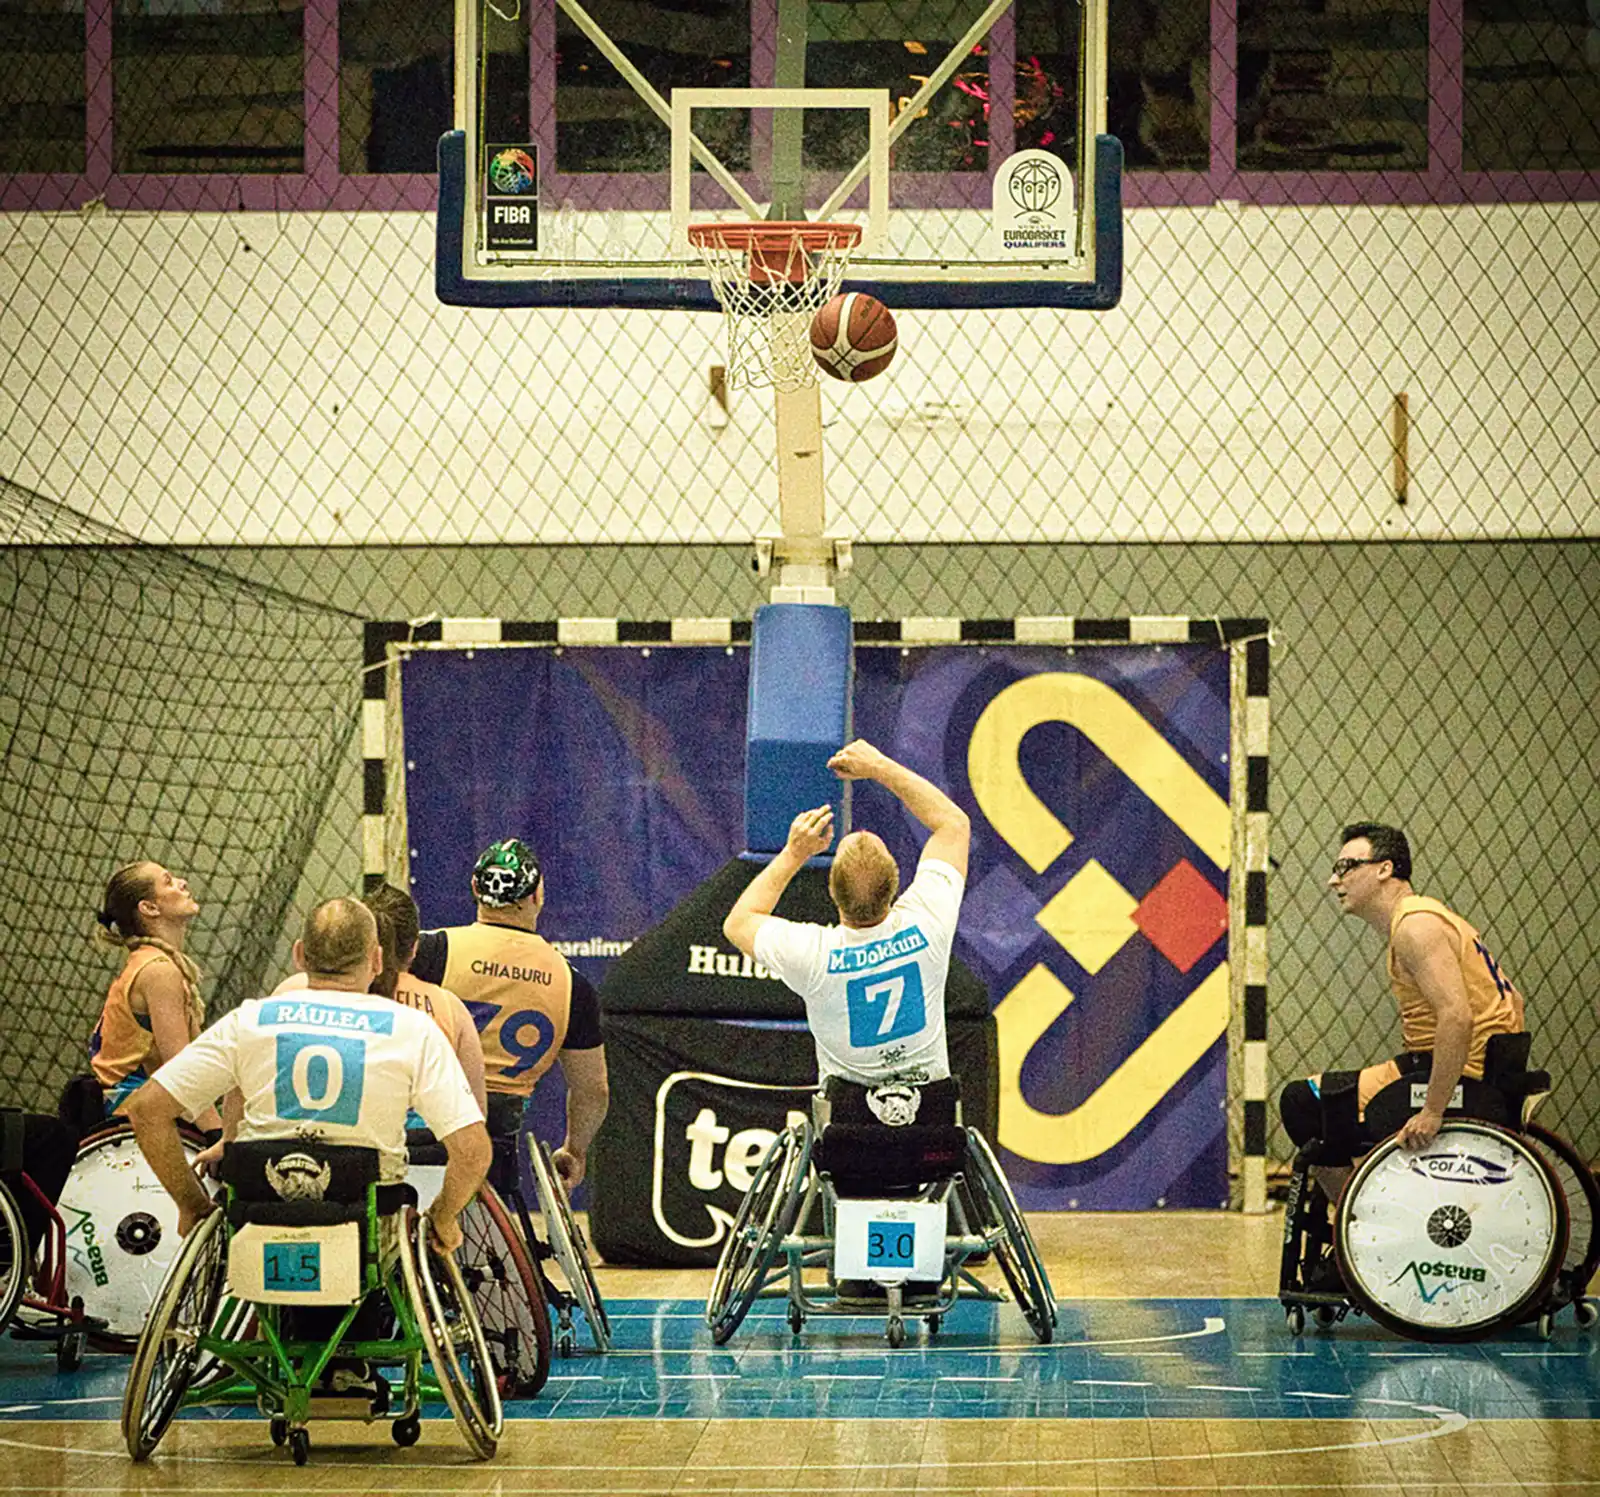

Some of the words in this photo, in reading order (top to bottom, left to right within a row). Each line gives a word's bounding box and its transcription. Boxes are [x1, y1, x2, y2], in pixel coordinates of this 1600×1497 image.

[1013, 180, 1057, 194] 2027
[494, 206, 531, 224] FIBA
[1003, 230, 1066, 241] EUROBASKET
[1003, 241, 1066, 250] QUALIFIERS
[830, 950, 851, 971] M.
[470, 959, 553, 987] CHIABURU
[864, 975, 905, 1037] 7
[292, 1044, 344, 1111] 0
[868, 1232, 914, 1259] 3.0
[266, 1254, 320, 1283] 1.5
